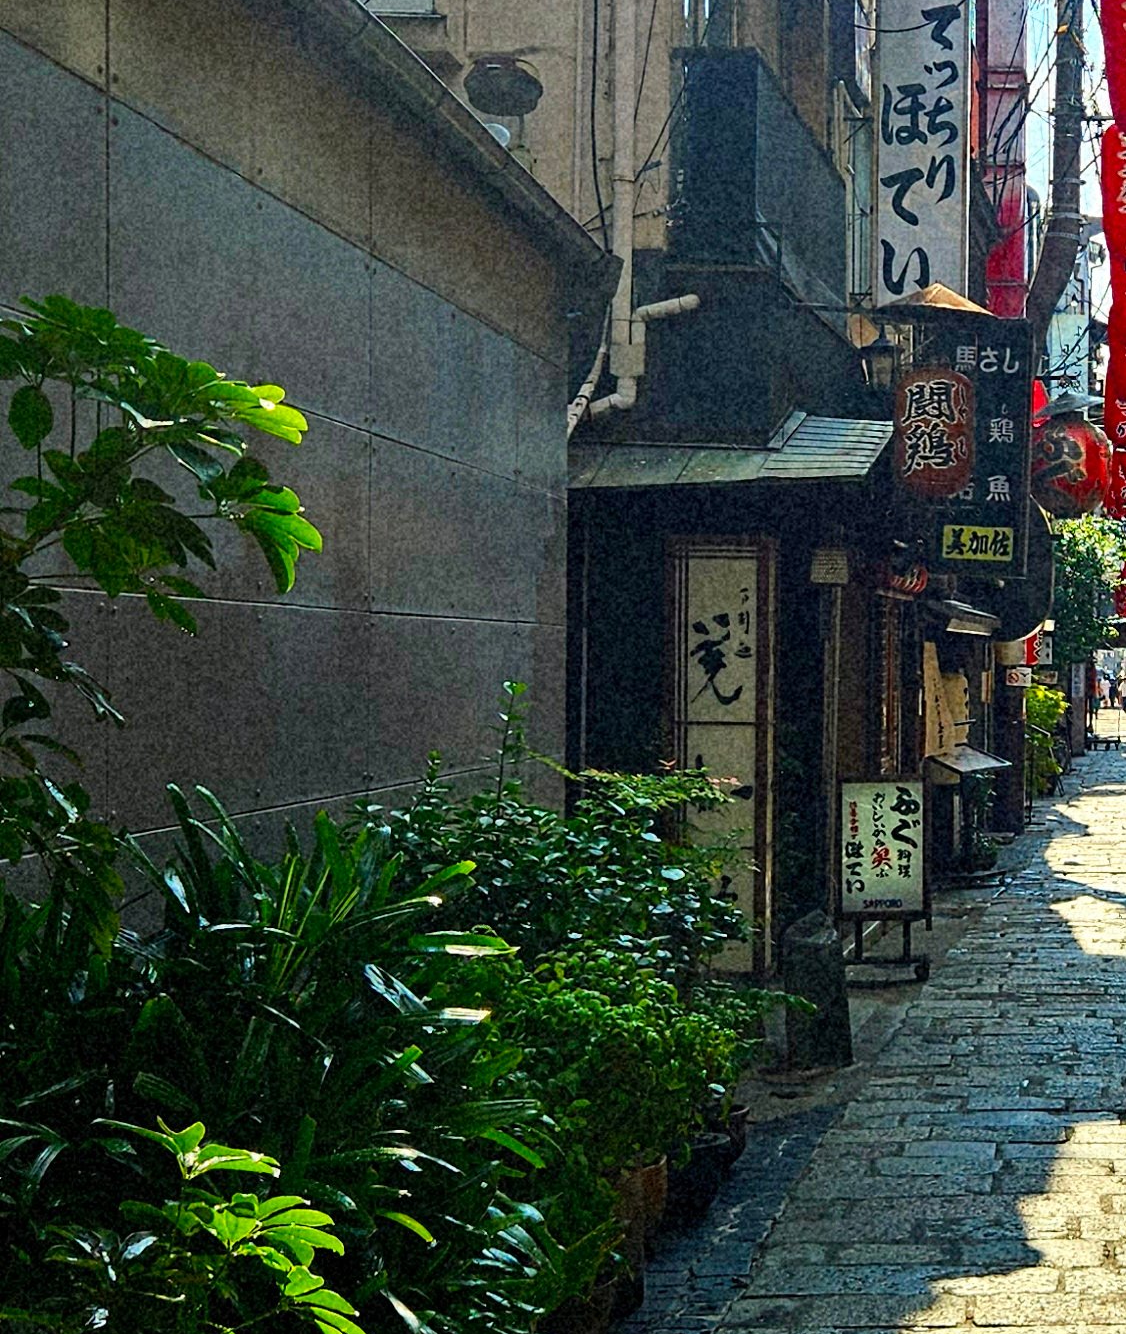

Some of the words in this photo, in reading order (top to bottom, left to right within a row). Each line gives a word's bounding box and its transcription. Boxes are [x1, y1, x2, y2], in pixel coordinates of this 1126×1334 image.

[921, 4, 962, 204] てっちり
[880, 83, 930, 296] ほてい
[955, 346, 1020, 373] 馬さし
[863, 898, 903, 909] SAPPORO
